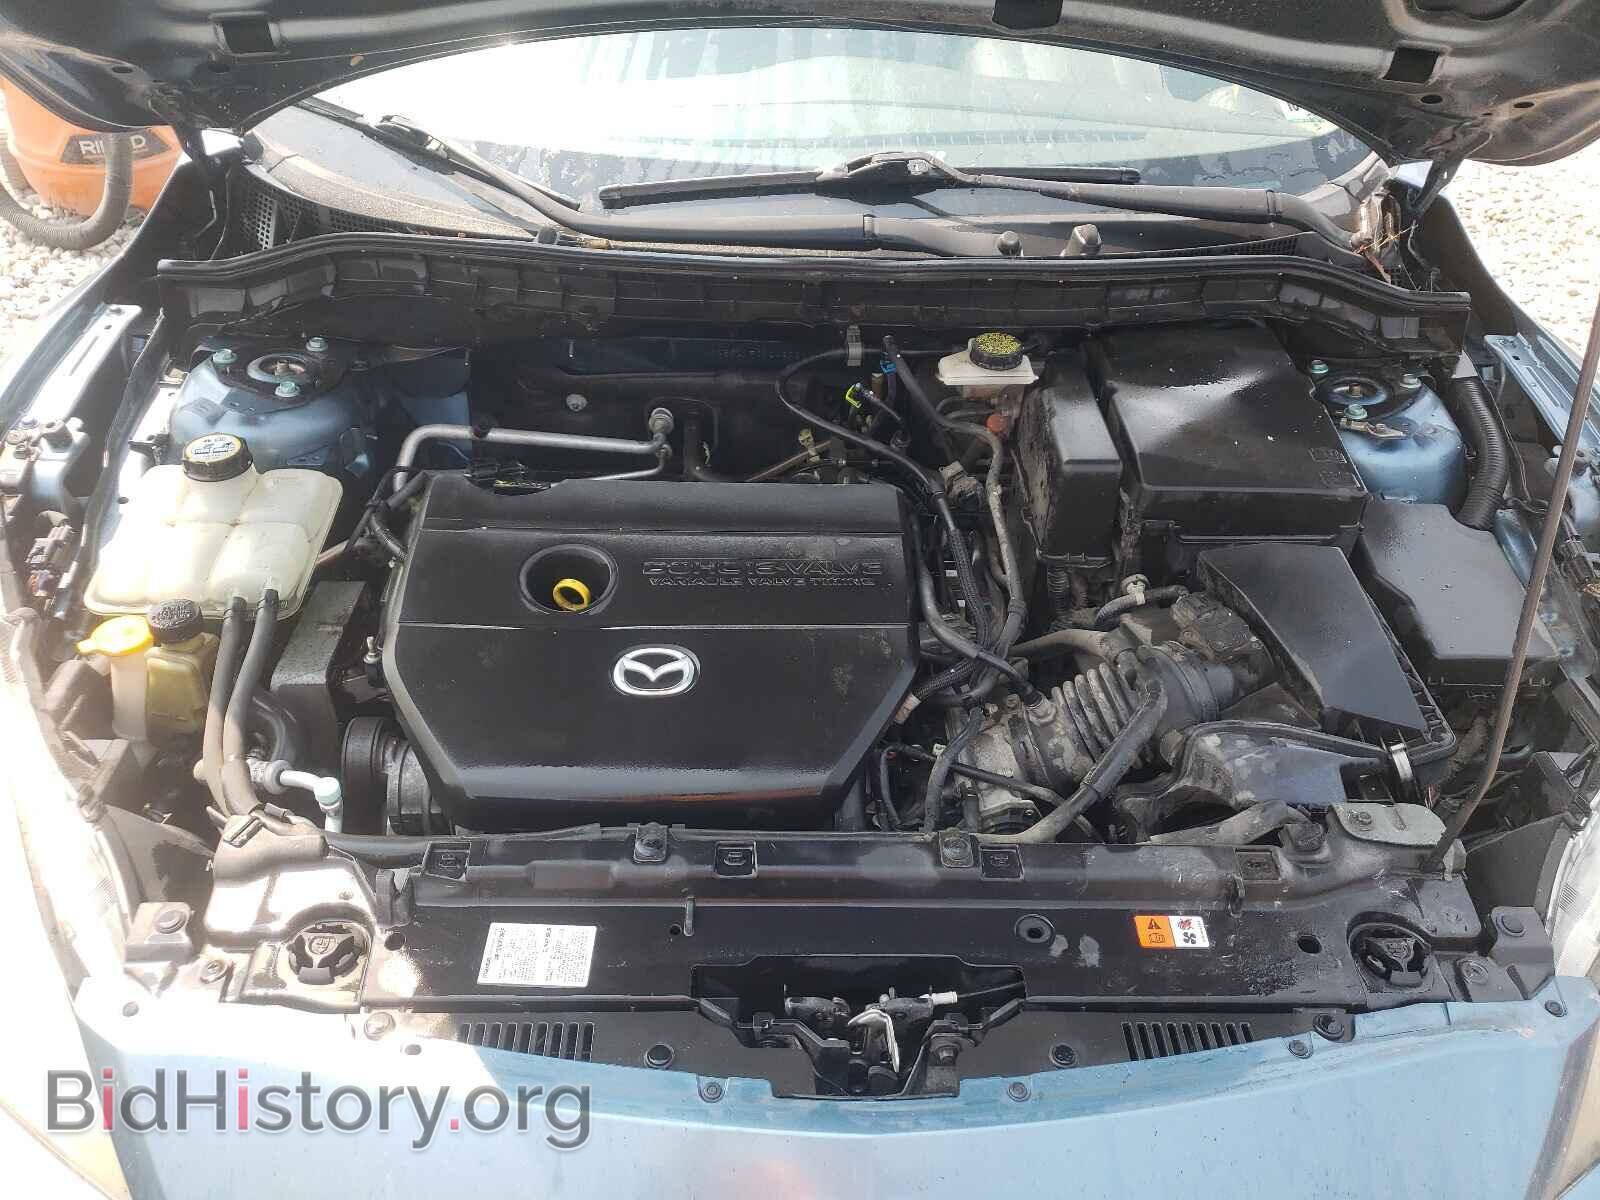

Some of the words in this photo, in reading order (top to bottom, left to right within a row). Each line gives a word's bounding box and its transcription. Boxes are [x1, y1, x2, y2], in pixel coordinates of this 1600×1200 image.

[643, 561, 739, 575] DOHC
[649, 577, 744, 586] VARIABLE
[748, 577, 807, 586] VALVE
